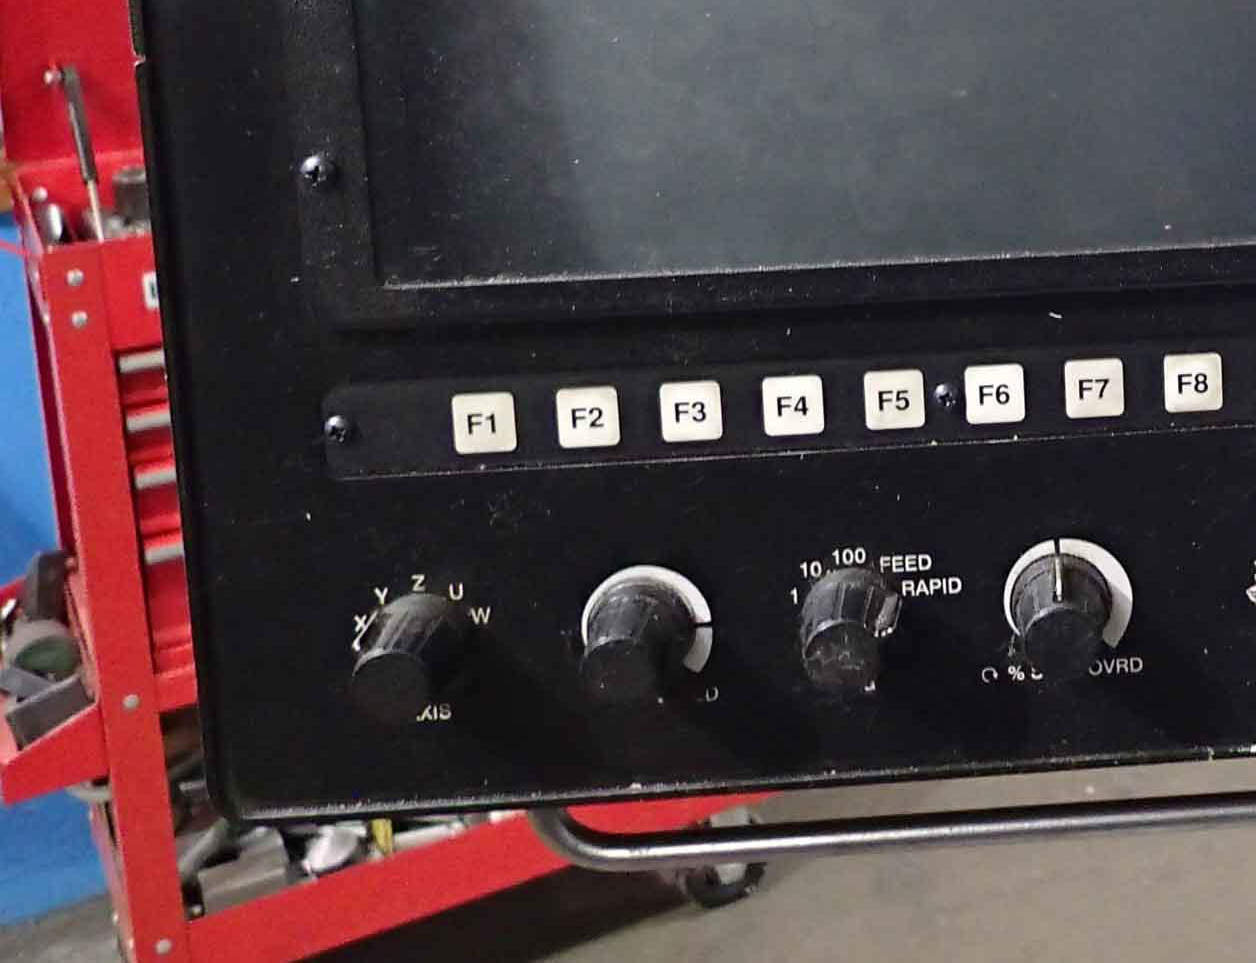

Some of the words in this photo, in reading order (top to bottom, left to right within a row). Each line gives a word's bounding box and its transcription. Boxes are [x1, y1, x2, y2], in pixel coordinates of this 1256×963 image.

[1078, 378, 1110, 400] F7
[1177, 373, 1209, 395] F8
[878, 390, 910, 412] F5
[978, 384, 1011, 406] F6
[674, 402, 707, 424] F3
[776, 395, 808, 418] F4
[466, 414, 498, 436] F1
[571, 408, 604, 429] F2
[831, 548, 866, 566] 100
[879, 554, 932, 573] FEED
[800, 561, 822, 579] 10
[411, 574, 425, 592] Z
[449, 583, 464, 601] U
[901, 577, 962, 598] RAPID
[374, 587, 388, 606] Y
[789, 587, 798, 605] 1
[470, 606, 491, 625] W
[416, 703, 452, 722] XIS
